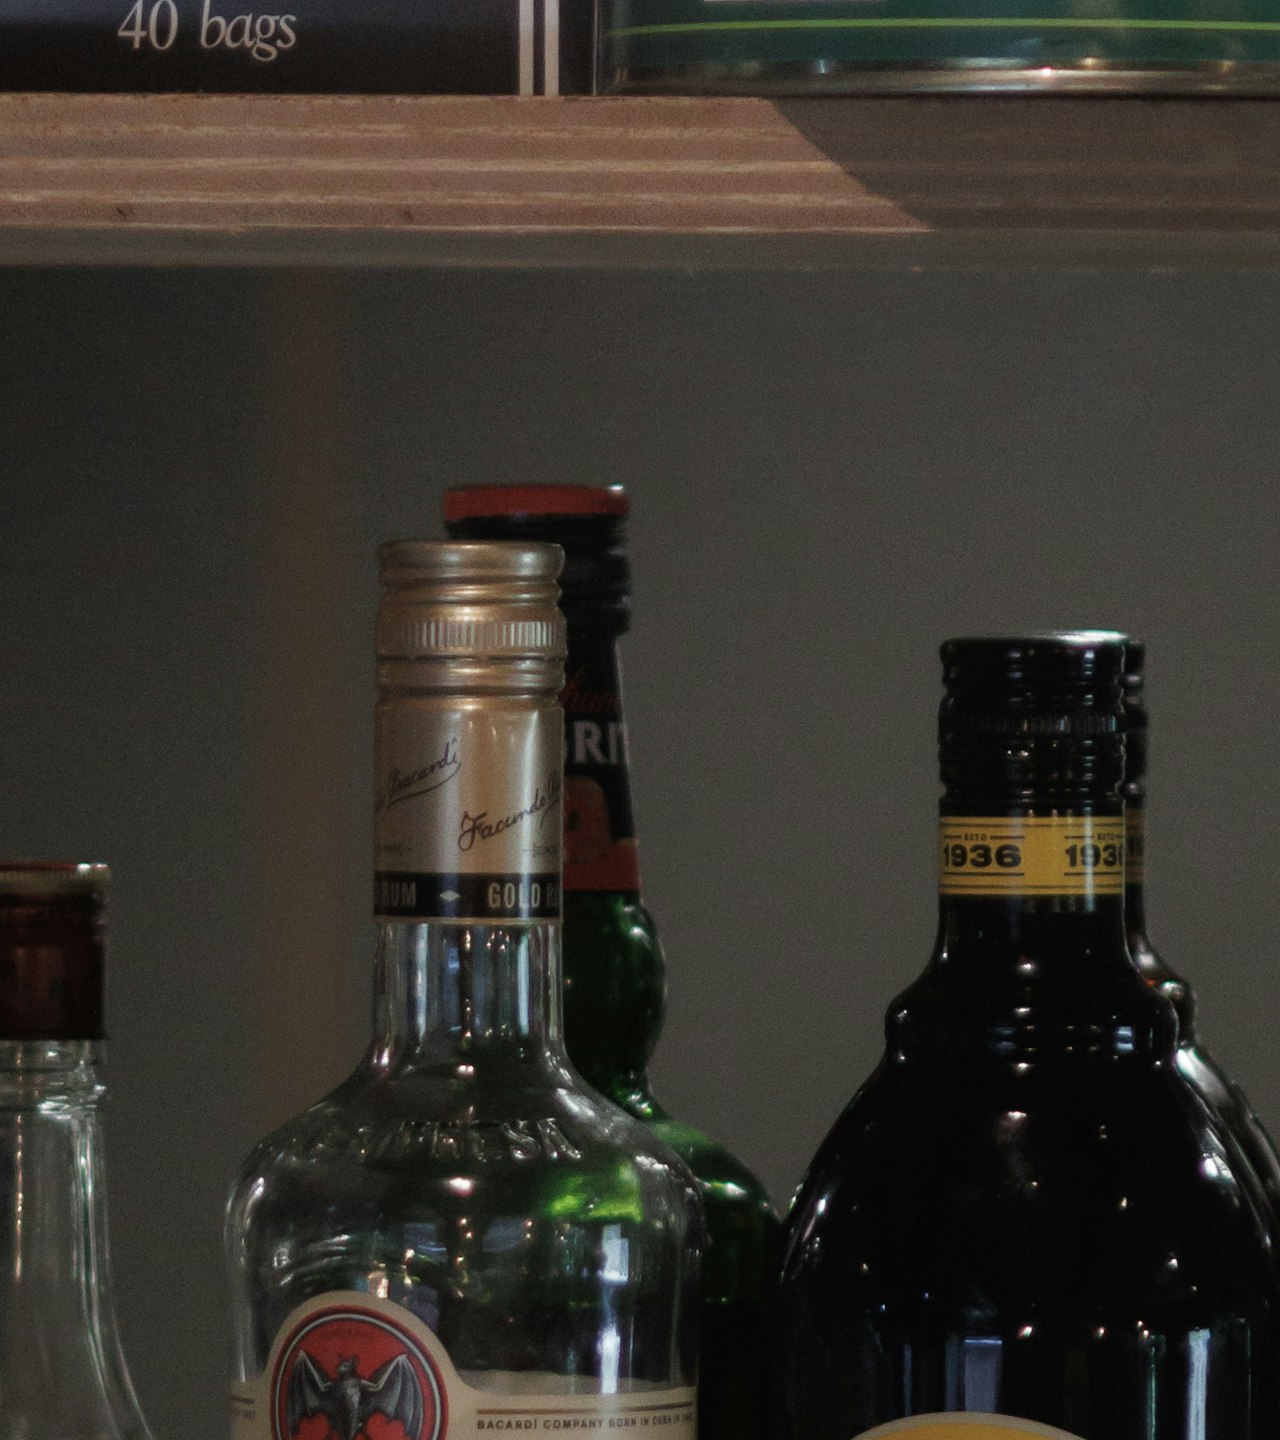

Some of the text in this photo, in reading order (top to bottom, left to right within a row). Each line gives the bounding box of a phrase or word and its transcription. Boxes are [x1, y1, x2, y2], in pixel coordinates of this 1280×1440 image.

[942, 843, 1022, 869] 1936
[487, 880, 542, 908] GOLD
[542, 1417, 603, 1430] COMPANY
